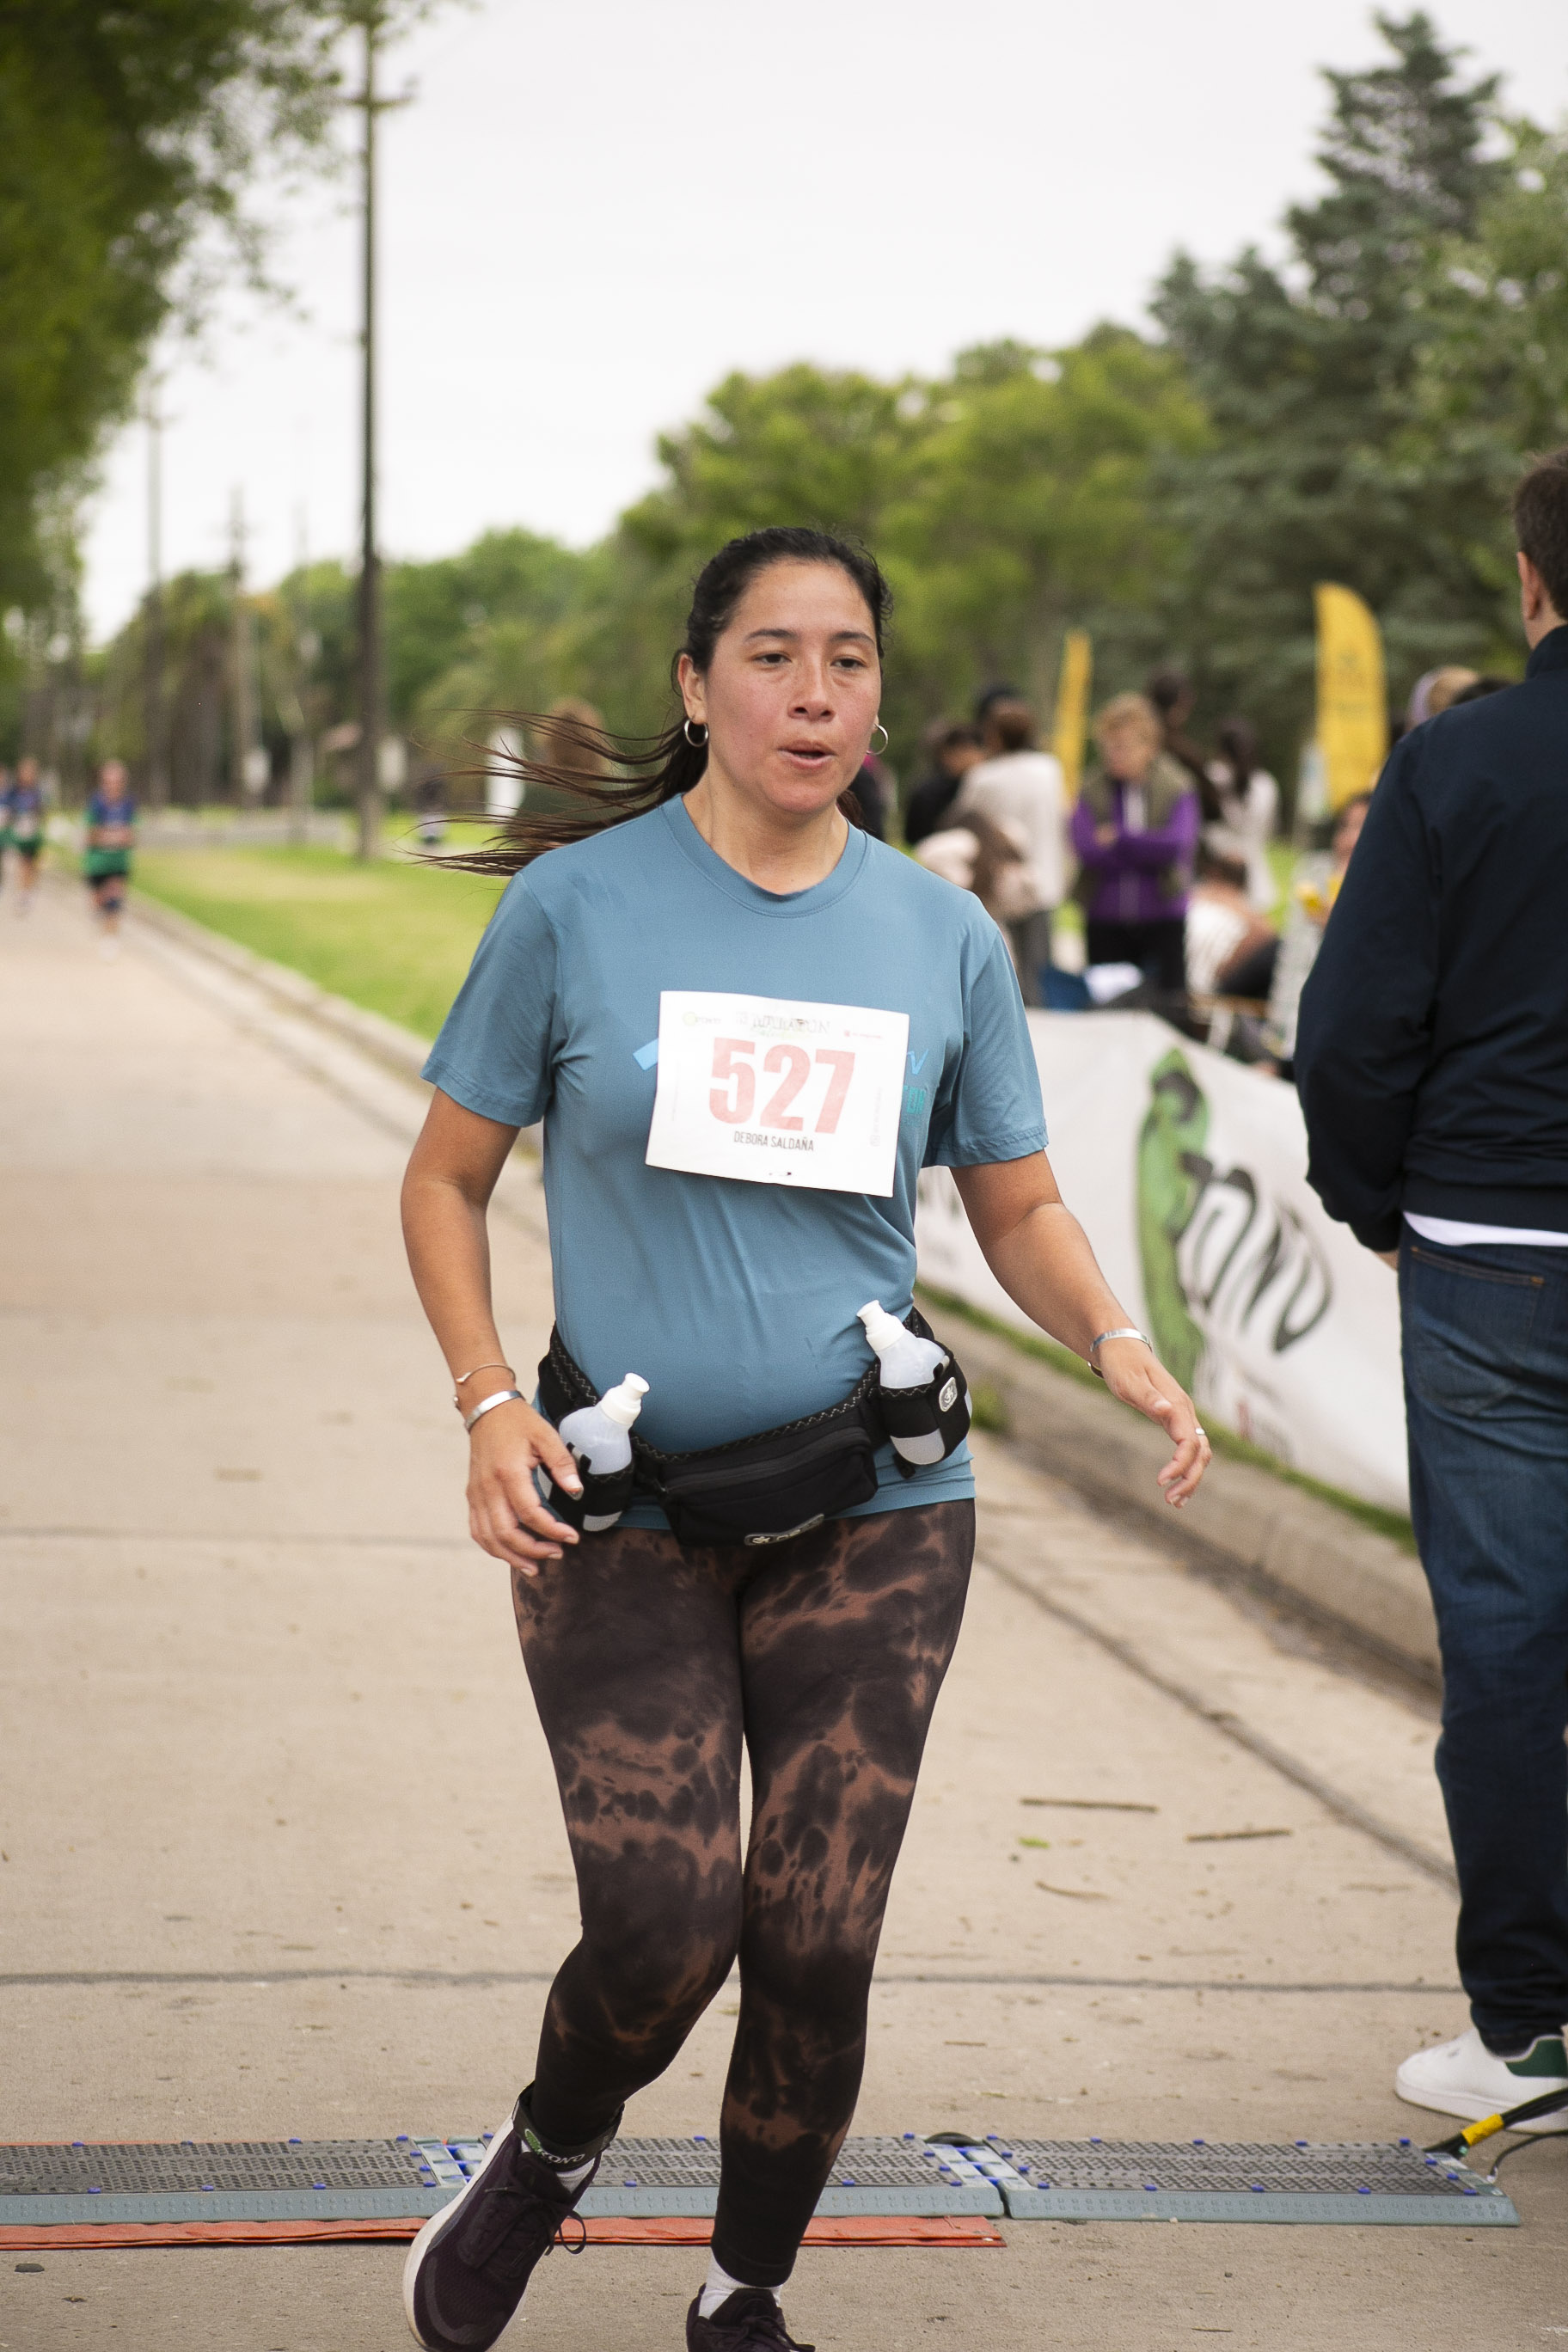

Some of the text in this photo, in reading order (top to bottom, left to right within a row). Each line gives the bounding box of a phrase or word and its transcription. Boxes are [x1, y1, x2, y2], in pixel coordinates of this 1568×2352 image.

[708, 1036, 856, 1135] 527
[733, 1130, 815, 1152] DEBORA SALDAÑA
